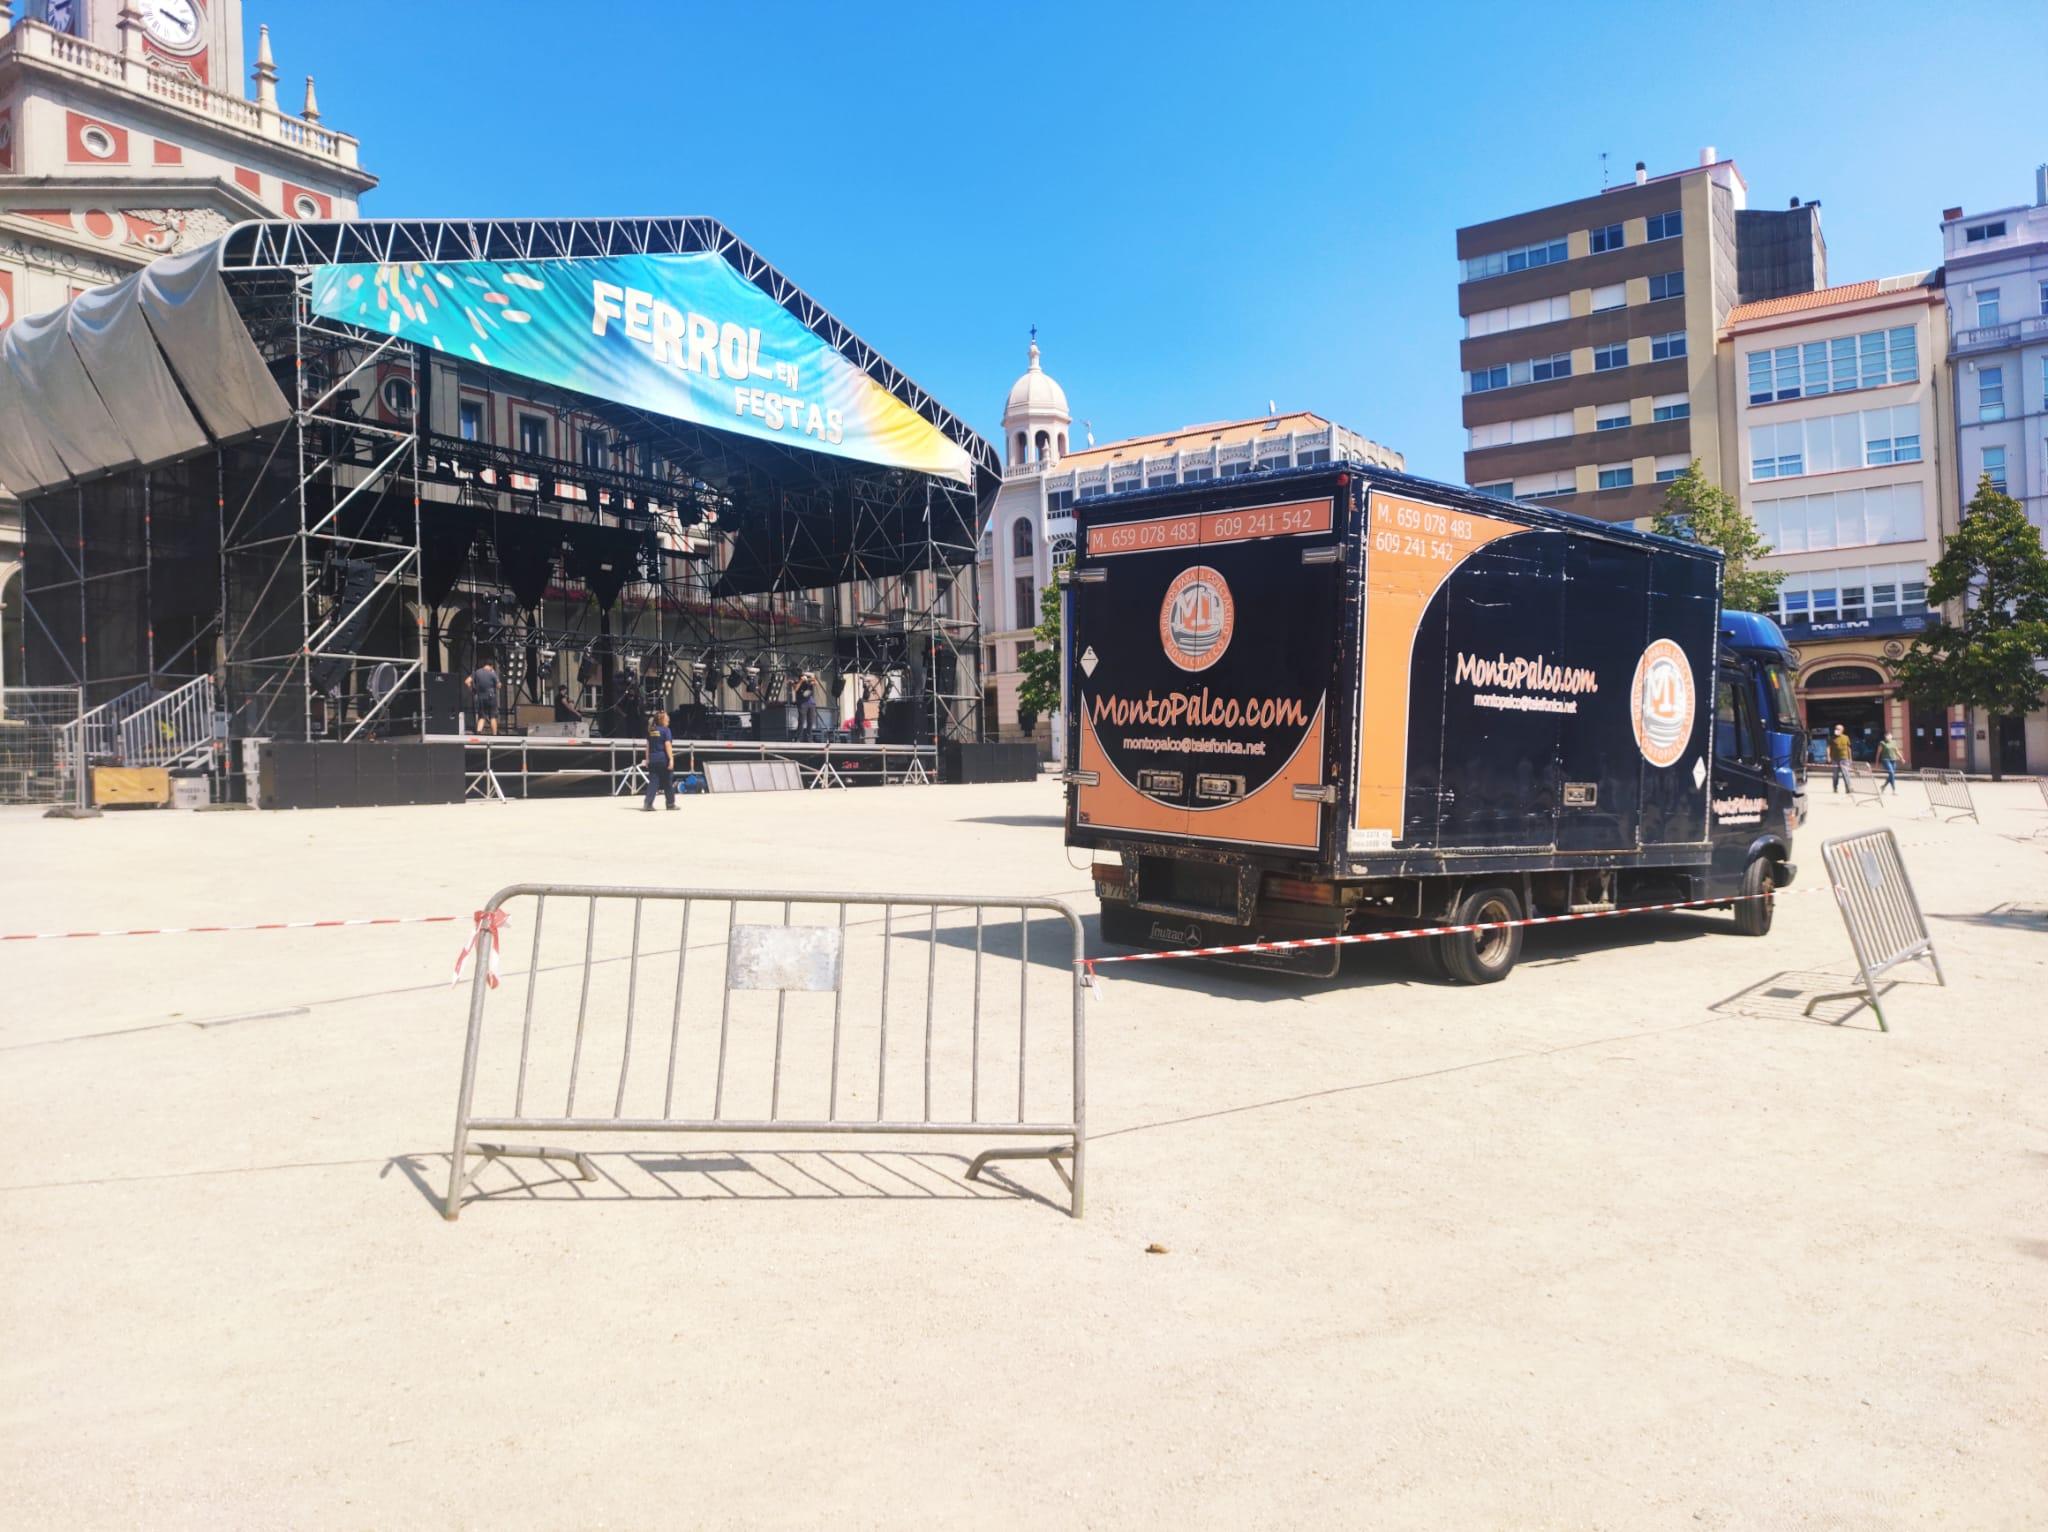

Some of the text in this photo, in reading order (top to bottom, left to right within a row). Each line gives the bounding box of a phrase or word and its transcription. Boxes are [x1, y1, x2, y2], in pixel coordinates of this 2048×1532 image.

[0, 239, 79, 271] ACIO
[592, 279, 800, 392] FERROL EN
[735, 387, 844, 446] FESTAS
[1092, 508, 1312, 549] M. 659 078 483 609 241 542
[1377, 502, 1472, 540] M. 659 078 483
[1376, 531, 1453, 561] 609 241 542
[1455, 651, 1598, 695] MontoPalco.com
[1093, 686, 1308, 729] MontoPalco.com
[1123, 735, 1266, 756] montopalco@telefonica.net
